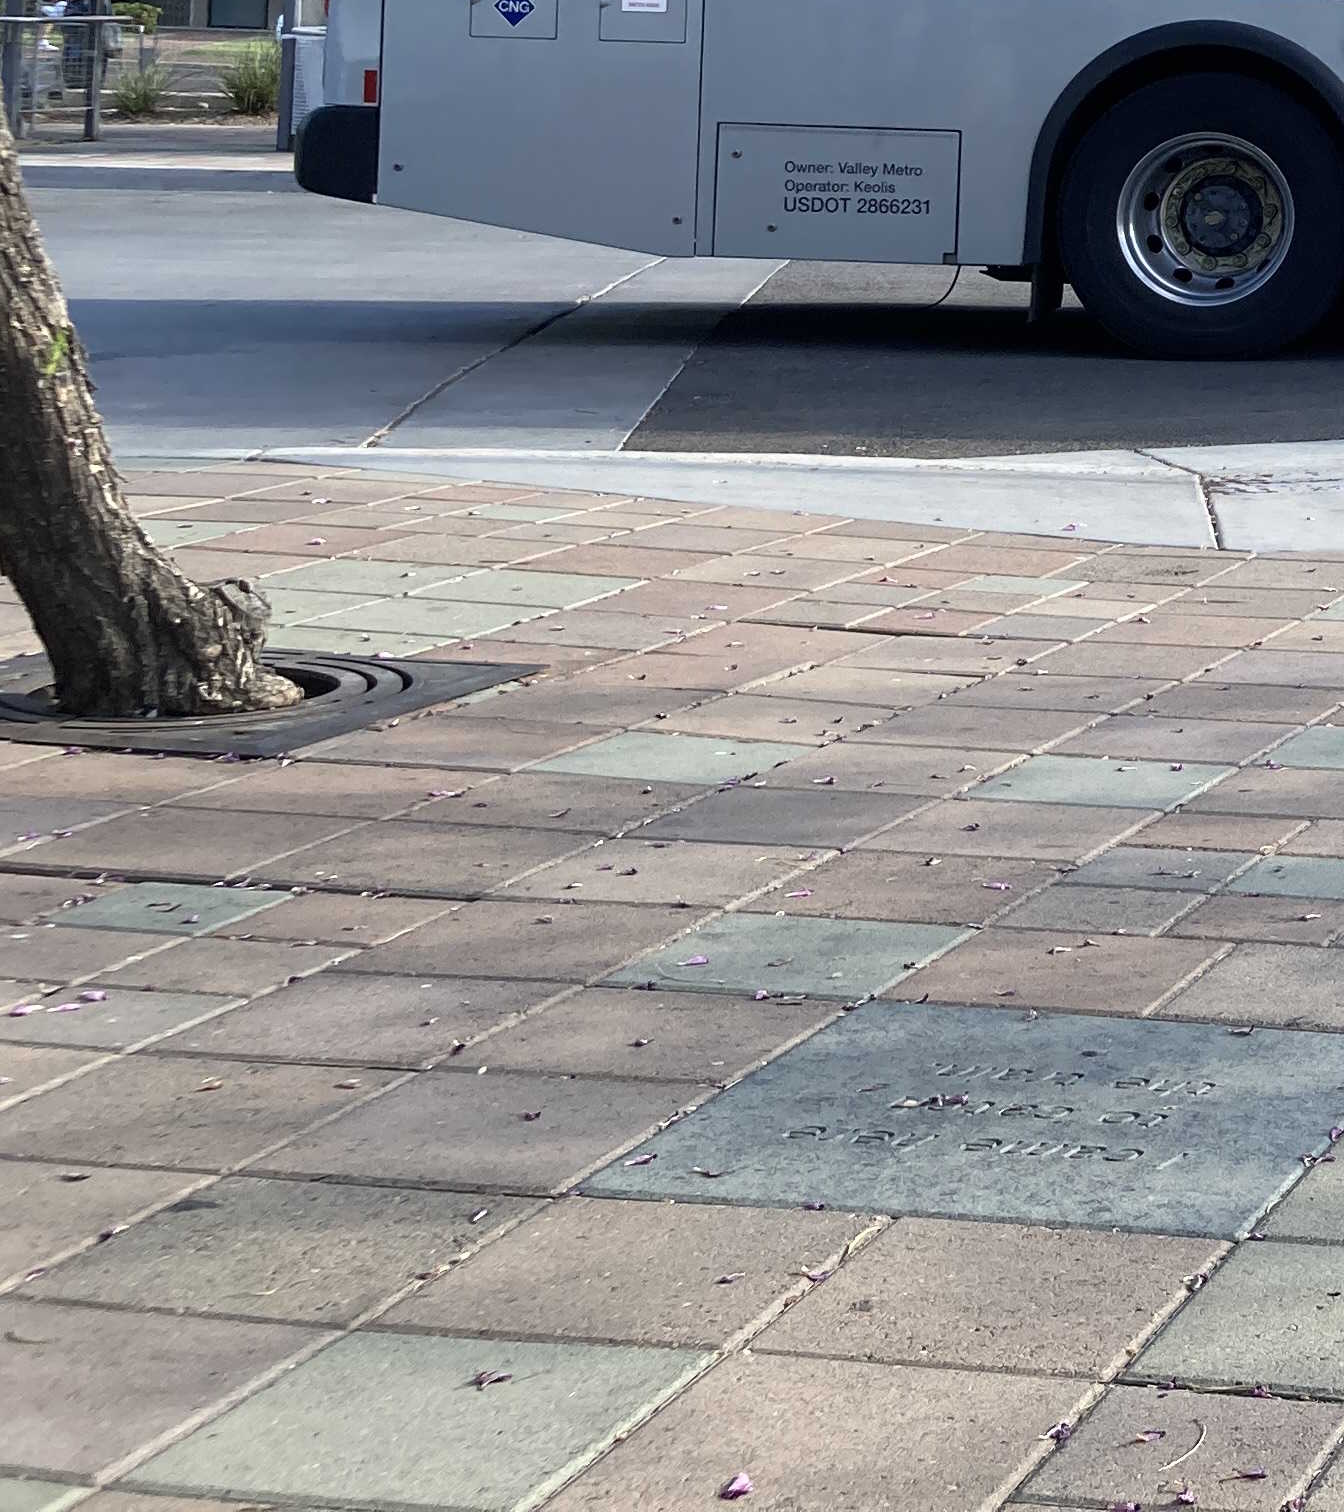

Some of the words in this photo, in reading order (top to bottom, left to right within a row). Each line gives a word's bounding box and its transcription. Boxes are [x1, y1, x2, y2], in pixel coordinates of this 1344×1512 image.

[498, 0, 531, 14] CNG
[784, 160, 834, 174] Owner:
[838, 162, 878, 177] Valley
[883, 163, 923, 177] Metro
[784, 179, 850, 194] Operator:
[854, 181, 896, 194] Keolis
[783, 196, 851, 213] USDOT
[856, 199, 931, 215] 2866231
[1113, 1077, 1217, 1097] the
[1099, 1109, 1169, 1129] to
[783, 1124, 940, 1153] here
[959, 1137, 1145, 1162] came
